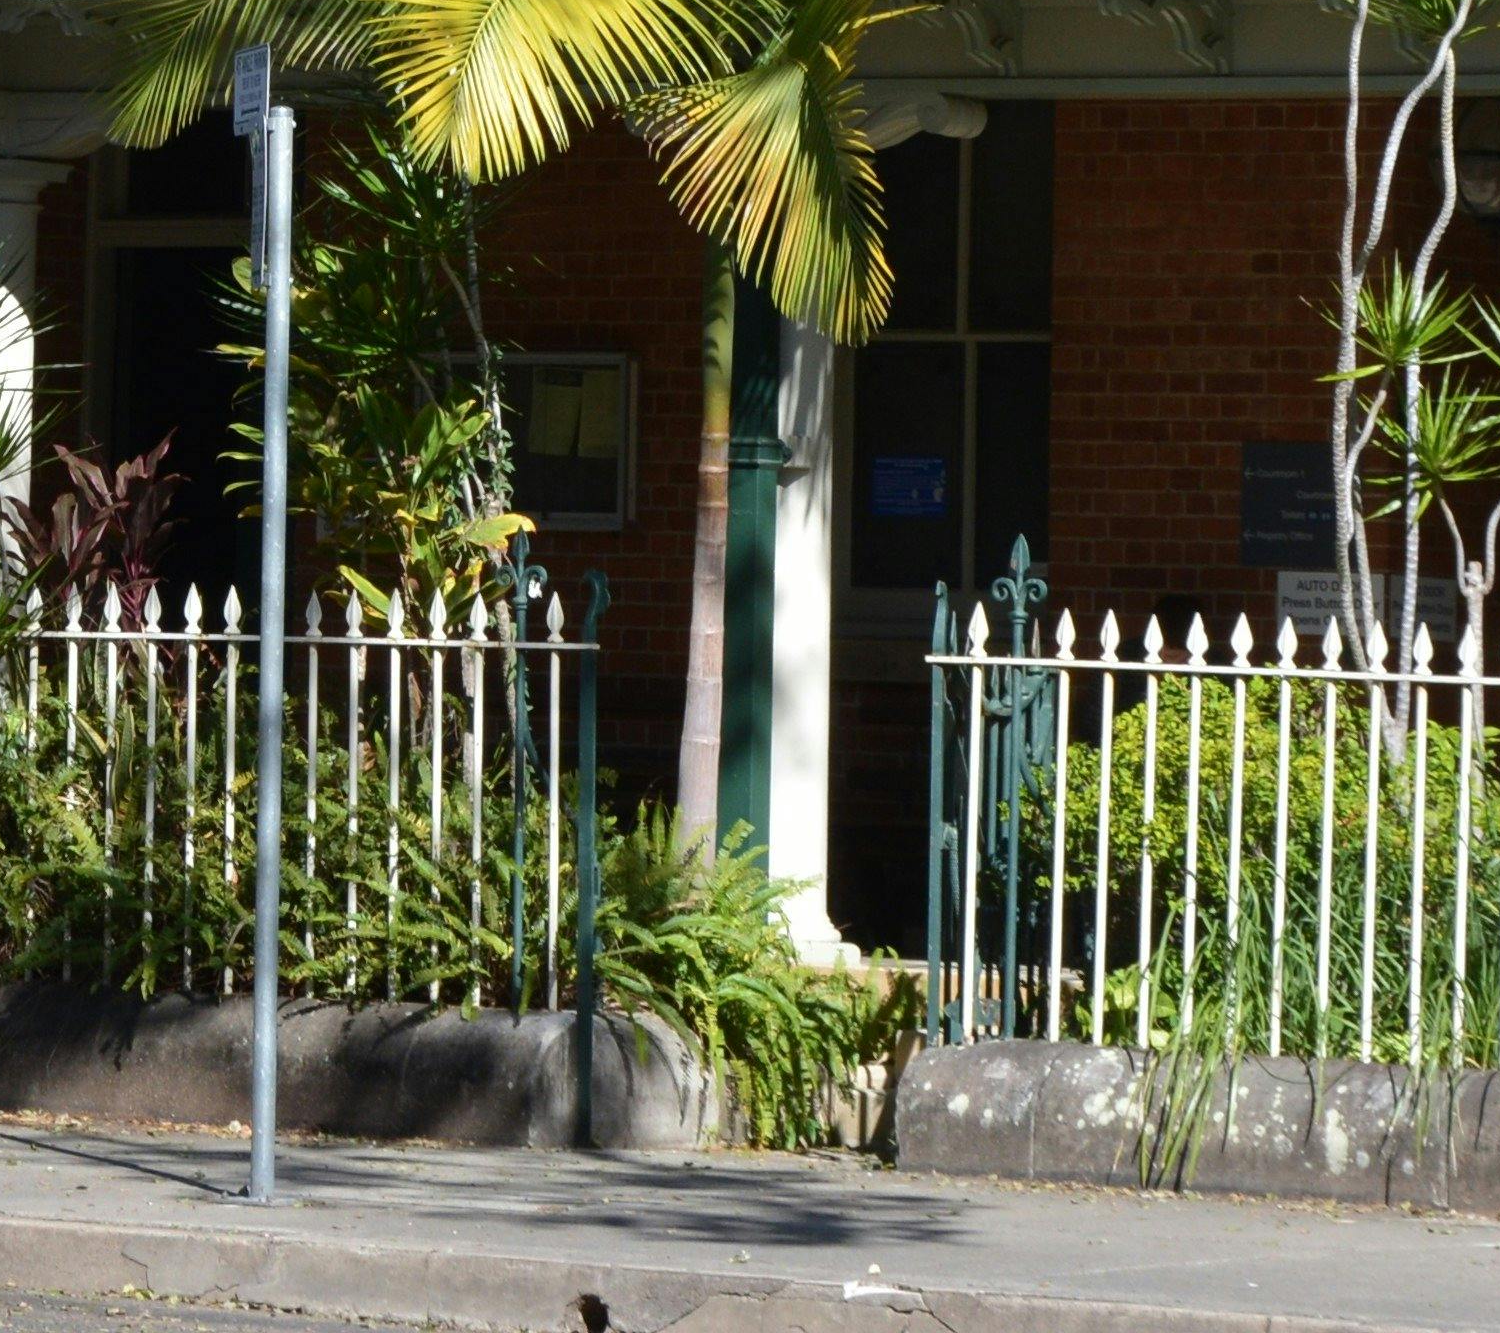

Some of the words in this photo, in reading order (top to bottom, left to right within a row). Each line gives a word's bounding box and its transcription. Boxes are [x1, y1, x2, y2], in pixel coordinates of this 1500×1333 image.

[1297, 580, 1328, 592] AUTO
[1282, 596, 1311, 609] Press
[1315, 597, 1344, 609] Butto
